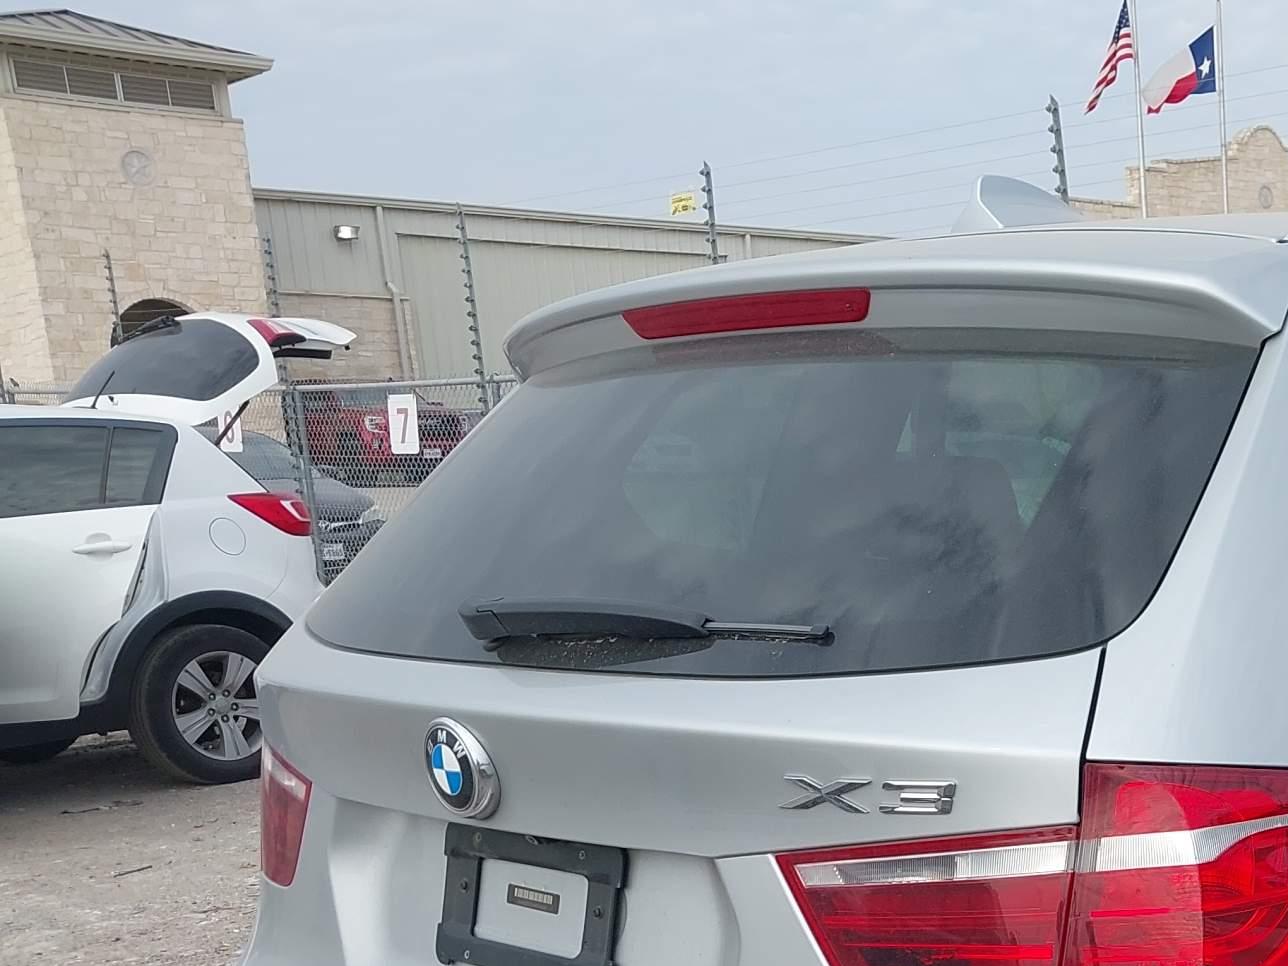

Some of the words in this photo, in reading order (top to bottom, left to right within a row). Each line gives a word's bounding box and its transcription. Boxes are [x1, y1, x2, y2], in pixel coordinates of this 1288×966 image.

[396, 408, 409, 444] 7
[427, 729, 466, 756] BMW
[778, 774, 956, 815] X3
